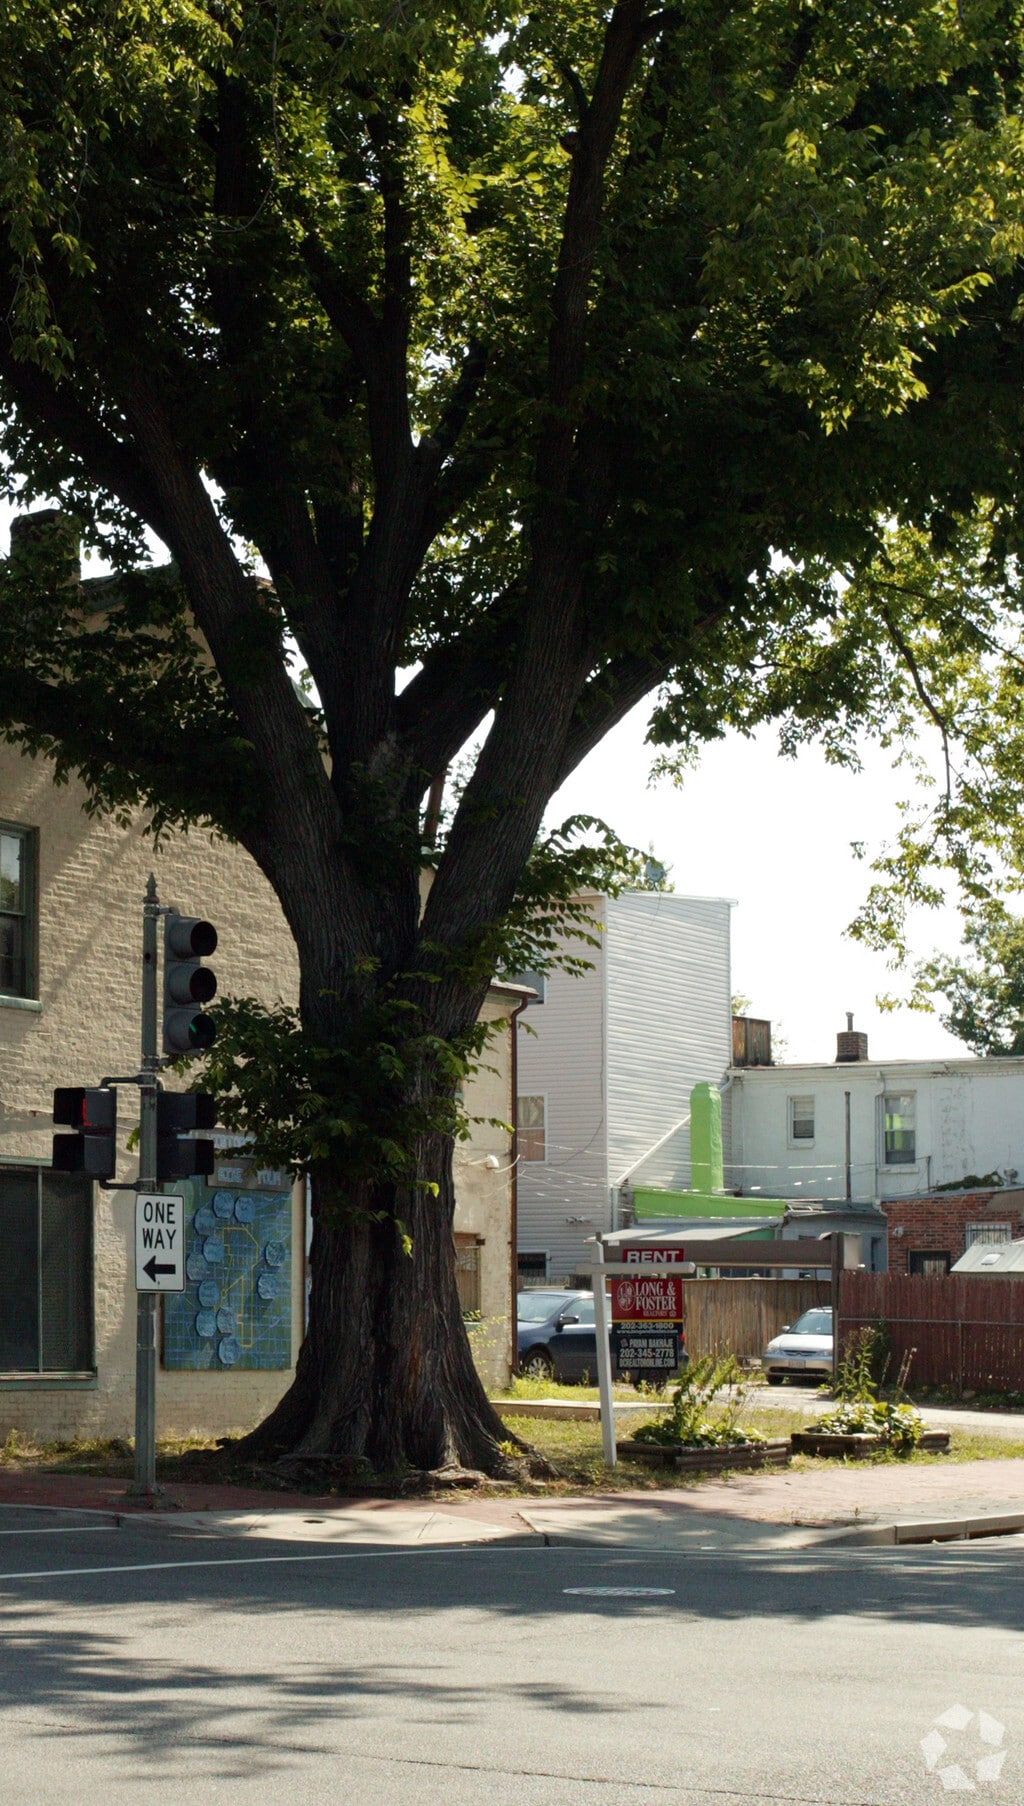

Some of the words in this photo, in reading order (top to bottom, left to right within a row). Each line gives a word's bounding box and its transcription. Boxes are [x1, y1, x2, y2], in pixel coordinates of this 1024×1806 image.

[143, 1201, 176, 1224] ONE
[142, 1227, 177, 1249] WAY
[627, 1250, 680, 1263] RENT
[636, 1281, 663, 1296] LONG
[667, 1281, 676, 1296] &
[636, 1296, 676, 1310] FOSTER
[620, 1348, 674, 1358] 202-345-2778
